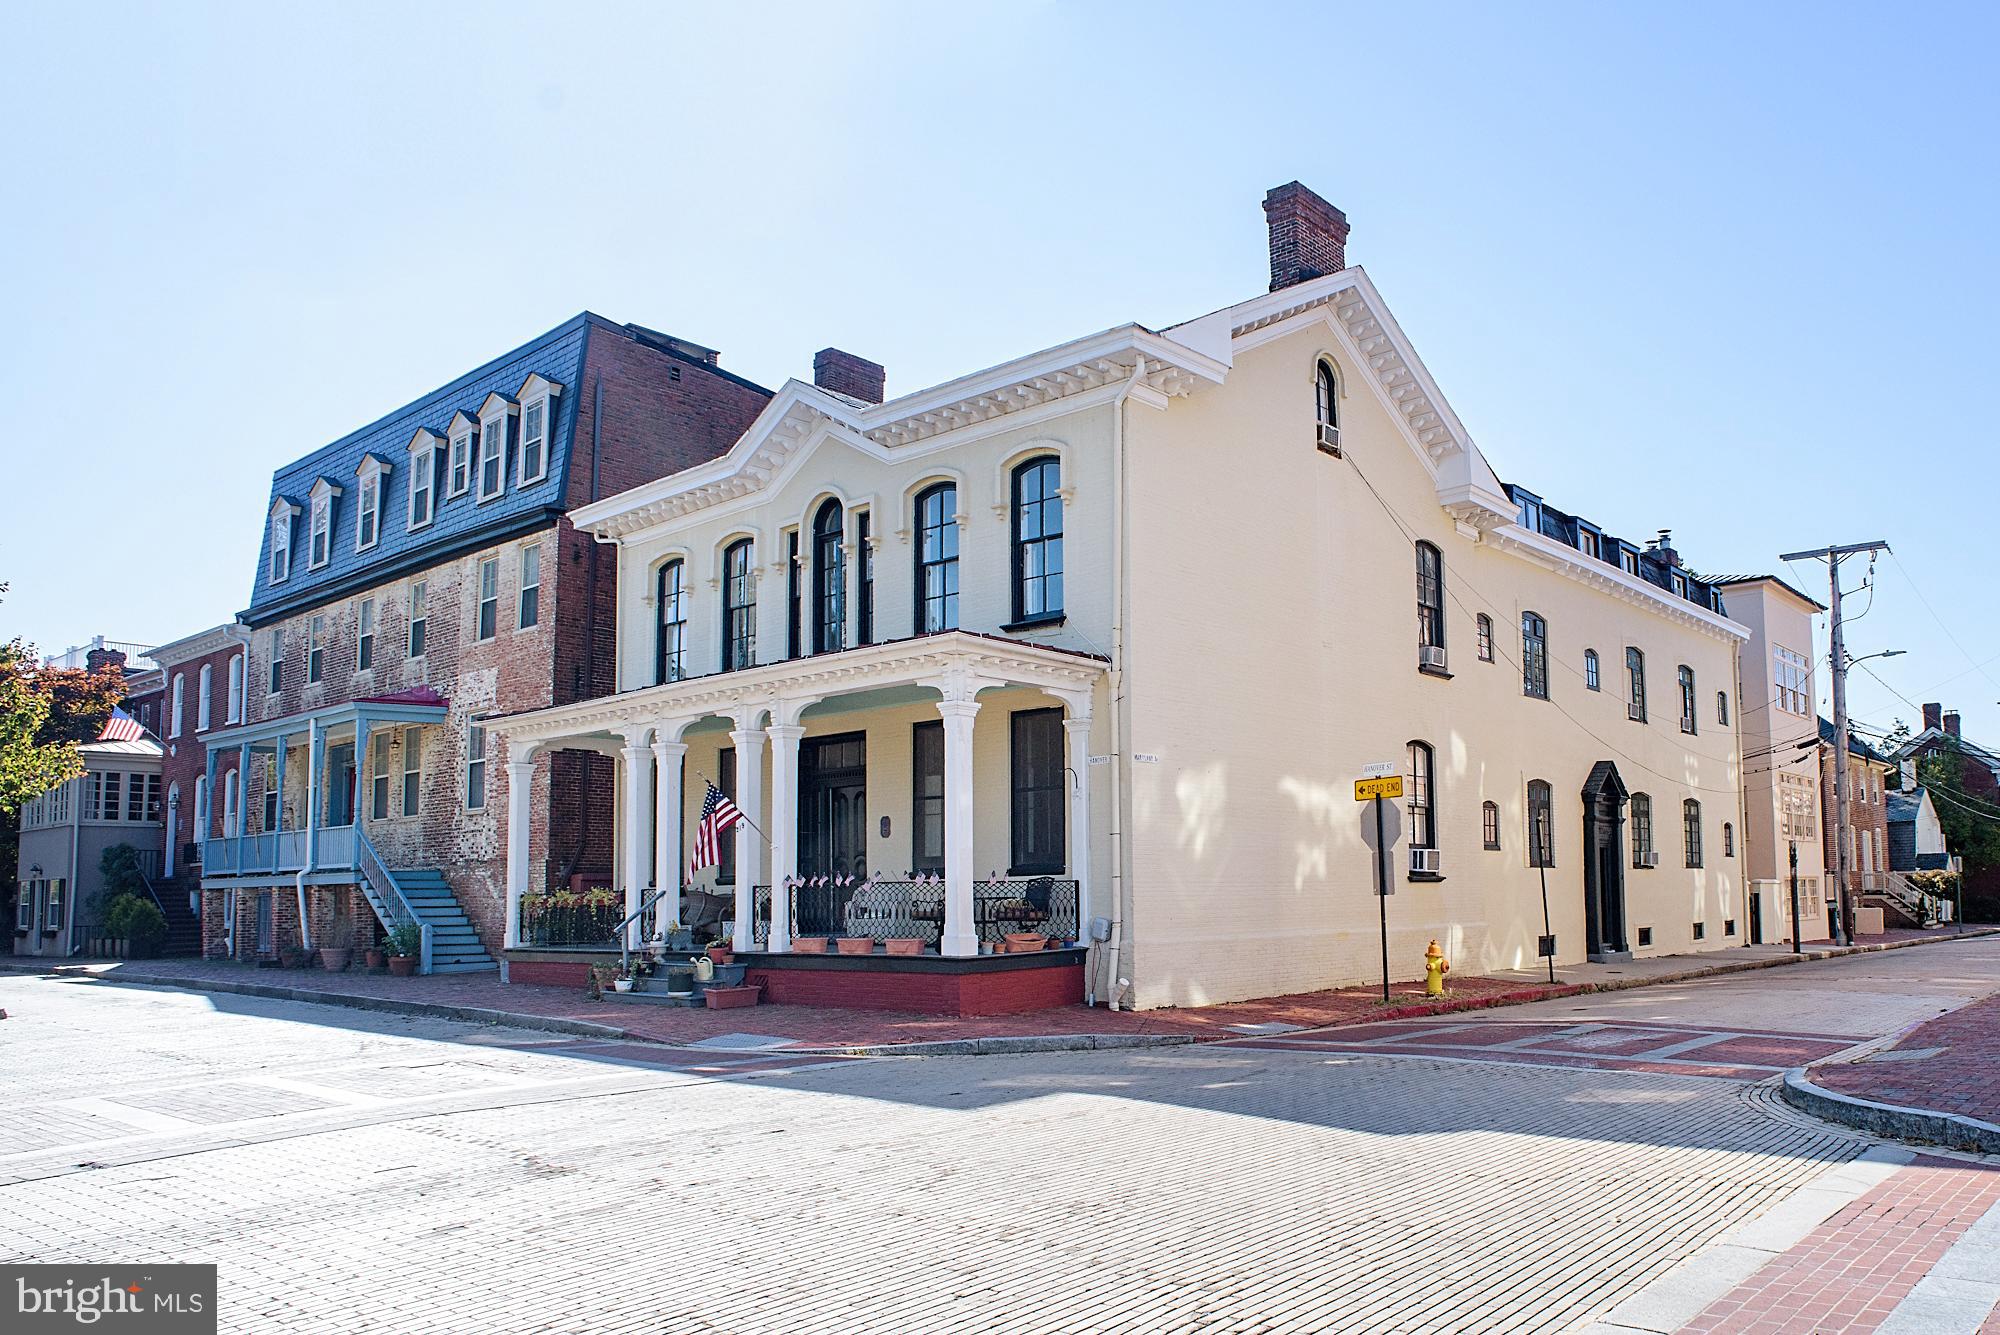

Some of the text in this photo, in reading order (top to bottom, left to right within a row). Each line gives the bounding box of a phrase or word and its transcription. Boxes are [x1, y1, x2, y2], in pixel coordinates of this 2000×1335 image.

[1362, 762, 1392, 773] HANOVER ST
[1367, 781, 1400, 794] DEAD END
